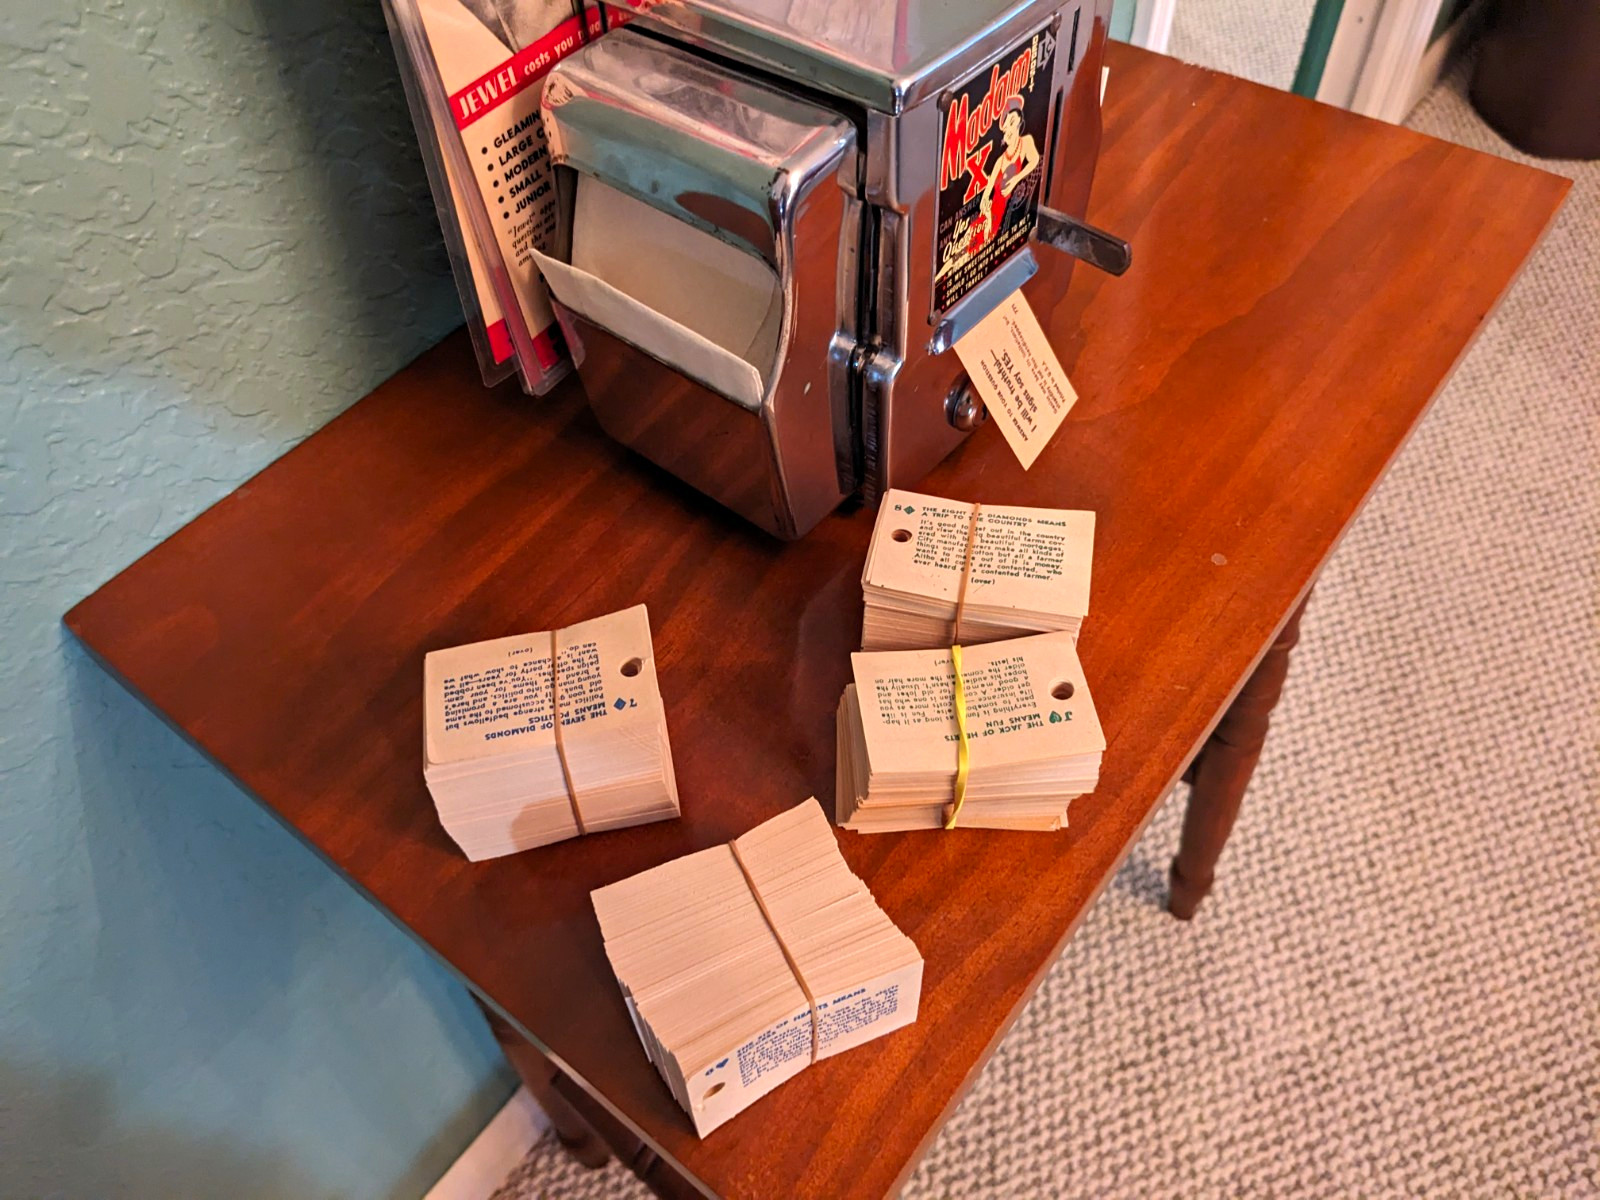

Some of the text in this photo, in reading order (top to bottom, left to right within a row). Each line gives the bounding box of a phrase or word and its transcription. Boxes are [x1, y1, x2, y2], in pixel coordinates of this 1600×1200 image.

[1029, 34, 1039, 93] DEPOSIT
[458, 35, 574, 119] JEWEL costs you
[941, 48, 1032, 190] Madam
[494, 110, 540, 149] GLEAMIN
[498, 137, 533, 166] LARGE
[504, 144, 548, 183] MODERN
[963, 140, 993, 204] X
[509, 170, 543, 199] SMALL
[515, 181, 552, 214] JUNIOR
[940, 217, 952, 233] CAN
[955, 196, 980, 222] ANSWER
[953, 218, 969, 246] Yes
[943, 220, 989, 263] Question
[947, 280, 953, 288] IS
[964, 243, 996, 274] SWEETHEART
[997, 231, 1009, 245] TRUE
[1011, 224, 1018, 233] TO
[946, 277, 965, 297] SHOULD
[970, 267, 977, 278] GO
[978, 257, 989, 272] INTO
[995, 244, 1005, 257] NEW
[946, 294, 958, 306] WILL
[999, 348, 1038, 414] signs say YES.
[979, 358, 1028, 442] ANSWER TO YOUR QUESTION
[1012, 393, 1023, 410] be
[1020, 406, 1033, 427] will
[987, 513, 1032, 522] DIAMONDS
[988, 518, 1027, 527] COUNTRY
[980, 537, 1014, 546] beautiful
[1020, 542, 1063, 552] mortgages,
[986, 532, 1020, 540] beautiful
[1036, 532, 1065, 540] country
[994, 544, 1015, 552] make
[915, 547, 1062, 569] wants money.
[1036, 555, 1063, 563] farmer
[934, 561, 956, 569] heard
[980, 567, 1019, 577] contented
[1023, 572, 1052, 581] farmer.
[996, 562, 1038, 572] contented,
[970, 576, 995, 585] (over)
[507, 646, 532, 657] (over)
[560, 644, 579, 653] do."
[459, 645, 597, 682] want chance show what
[520, 664, 542, 675] party
[987, 658, 1009, 666] jests.
[1003, 662, 1025, 670] older
[444, 658, 599, 698] paign "You've been robbed
[444, 669, 589, 704] brand theme your cam-
[887, 675, 903, 685] hair
[891, 668, 1027, 692] hopes hasn't. Usually
[444, 672, 601, 711] young into politics, here's
[896, 676, 1019, 698] good jokes
[989, 685, 1015, 693] older.
[444, 683, 583, 717] bunk. promising
[629, 698, 637, 708] 7
[931, 700, 952, 708] costs
[976, 692, 1017, 702] insurance
[1014, 694, 1035, 702] pens
[445, 689, 586, 724] soon accustomed same
[463, 692, 604, 727] Politics strange bedfellows
[573, 702, 605, 714] MEANS
[589, 709, 607, 718] THE
[881, 711, 895, 719] like
[991, 701, 1037, 713] Everything
[540, 720, 552, 729] OF
[882, 718, 900, 726] hap-
[984, 713, 1041, 727] MEANS FUN
[1064, 711, 1072, 721] J
[484, 724, 535, 740] DIAMONDS
[943, 720, 1044, 741] THE JACK OF HERTS
[794, 1003, 828, 1021] HEATS
[833, 988, 866, 1005] MEANS
